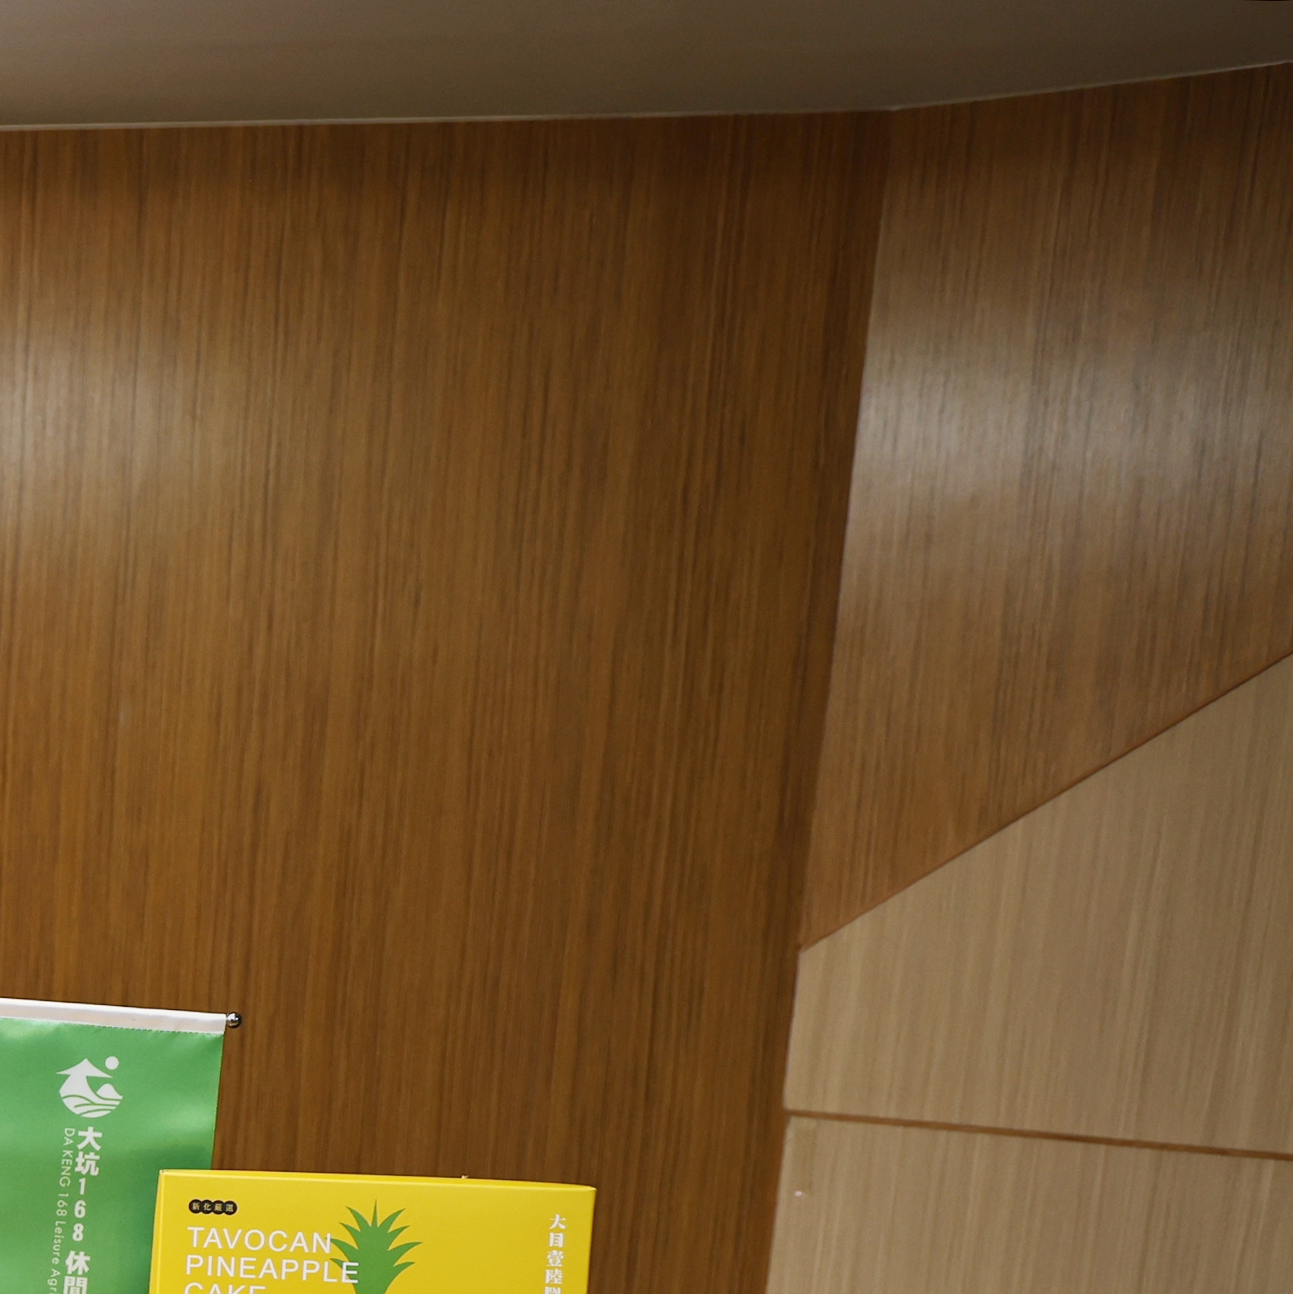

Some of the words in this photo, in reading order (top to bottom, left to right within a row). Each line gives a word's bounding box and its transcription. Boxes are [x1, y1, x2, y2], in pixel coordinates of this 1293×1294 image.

[63, 1127, 76, 1146] DA
[59, 1149, 73, 1187] KENG
[56, 1193, 69, 1217] 168
[50, 1220, 67, 1265] Leisure
[187, 1226, 332, 1254] TAVOCAN
[186, 1254, 360, 1284] PINEAPPLE
